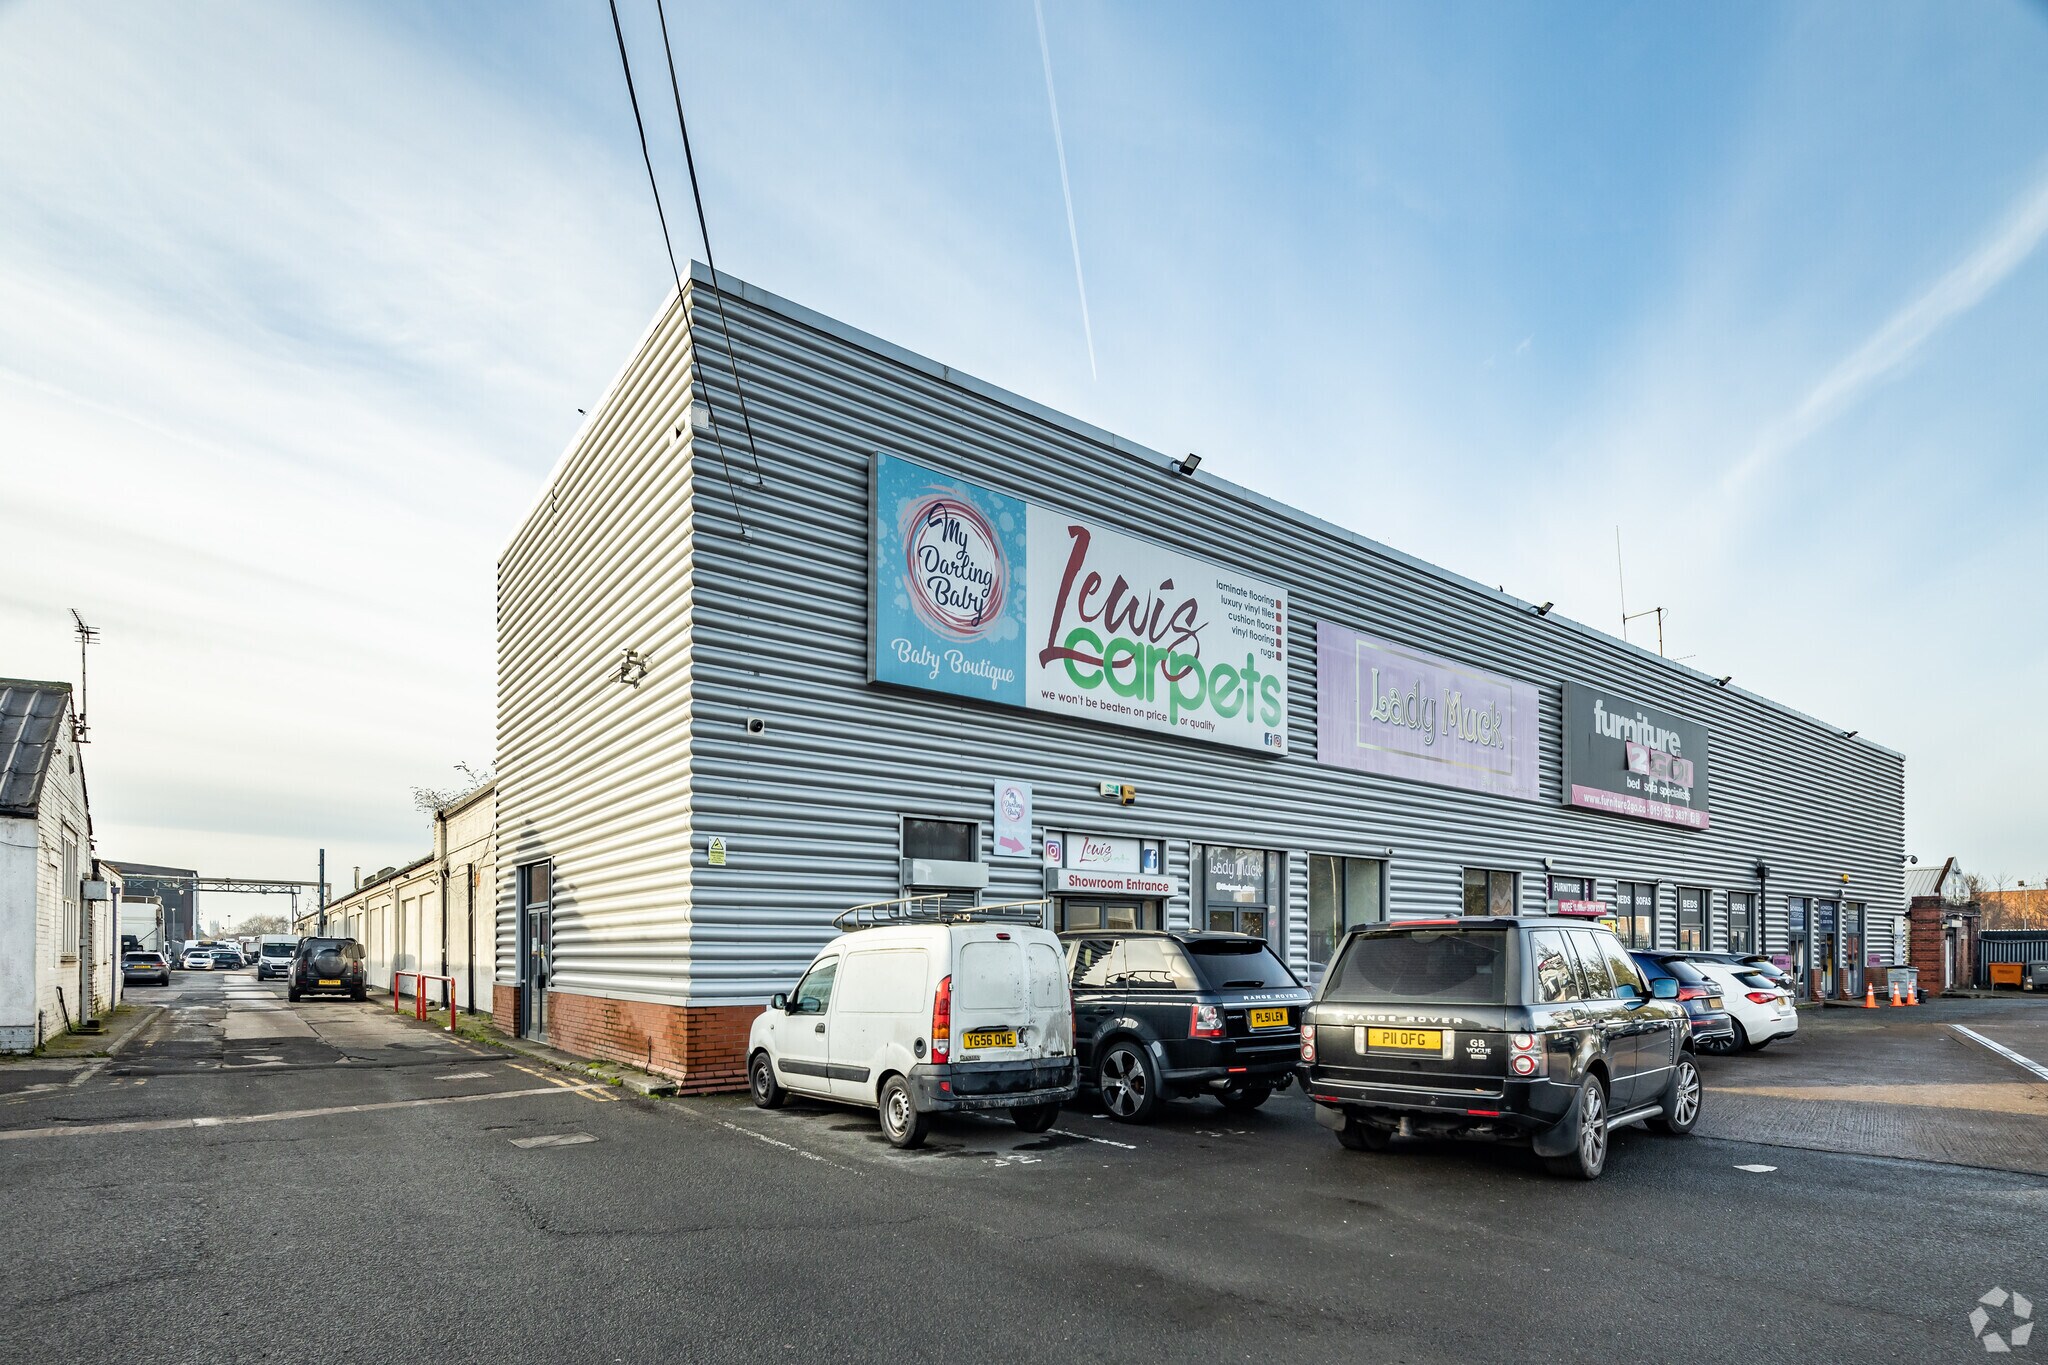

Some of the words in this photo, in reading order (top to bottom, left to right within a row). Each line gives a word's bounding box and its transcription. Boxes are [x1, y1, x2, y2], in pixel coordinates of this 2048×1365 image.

[928, 503, 967, 560] My
[918, 545, 992, 597] Darling
[927, 576, 983, 627] Baby
[1039, 526, 1209, 682] Lewis
[1216, 579, 1248, 598] laminate
[1249, 590, 1275, 608] flooring
[1220, 594, 1242, 611] luxury
[1244, 602, 1261, 616] vinyl
[1262, 606, 1275, 619] tiles
[1228, 612, 1256, 627] cushion
[1256, 618, 1275, 632] floors
[1231, 626, 1248, 639] vinyl
[1249, 629, 1275, 647] flooring
[1260, 648, 1275, 659] rugs
[891, 638, 940, 679] Baby
[944, 649, 1015, 691] Boutique
[1063, 627, 1282, 728] carpets
[1041, 690, 1056, 701] we
[1058, 692, 1084, 706] won't
[1086, 697, 1098, 709] be
[1100, 699, 1132, 716] beaten
[1134, 708, 1145, 718] on
[1146, 710, 1168, 722] price
[1180, 717, 1188, 726] or
[1190, 718, 1216, 732] quality
[1369, 667, 1436, 746] Lady
[1442, 688, 1504, 750] Muck
[1594, 700, 1681, 757] furniture
[1627, 776, 1640, 790] bed
[1644, 781, 1658, 794] sofa
[1659, 784, 1690, 802] specialists
[1210, 858, 1234, 879] Lady
[1069, 874, 1124, 890] Showroom
[1126, 878, 1170, 892] Entrance
[1554, 882, 1580, 894] FURNITURE
[1636, 896, 1652, 906] SOFAS
[1682, 900, 1698, 908] BEDS
[1732, 902, 1746, 912] SOFAS
[1346, 1014, 1396, 1022] RANGE
[1406, 1016, 1463, 1024] ROVER
[968, 1034, 992, 1046] YG56
[994, 1034, 1012, 1045] OWE
[1400, 1033, 1426, 1046] OFG
[1470, 1039, 1486, 1048] GB
